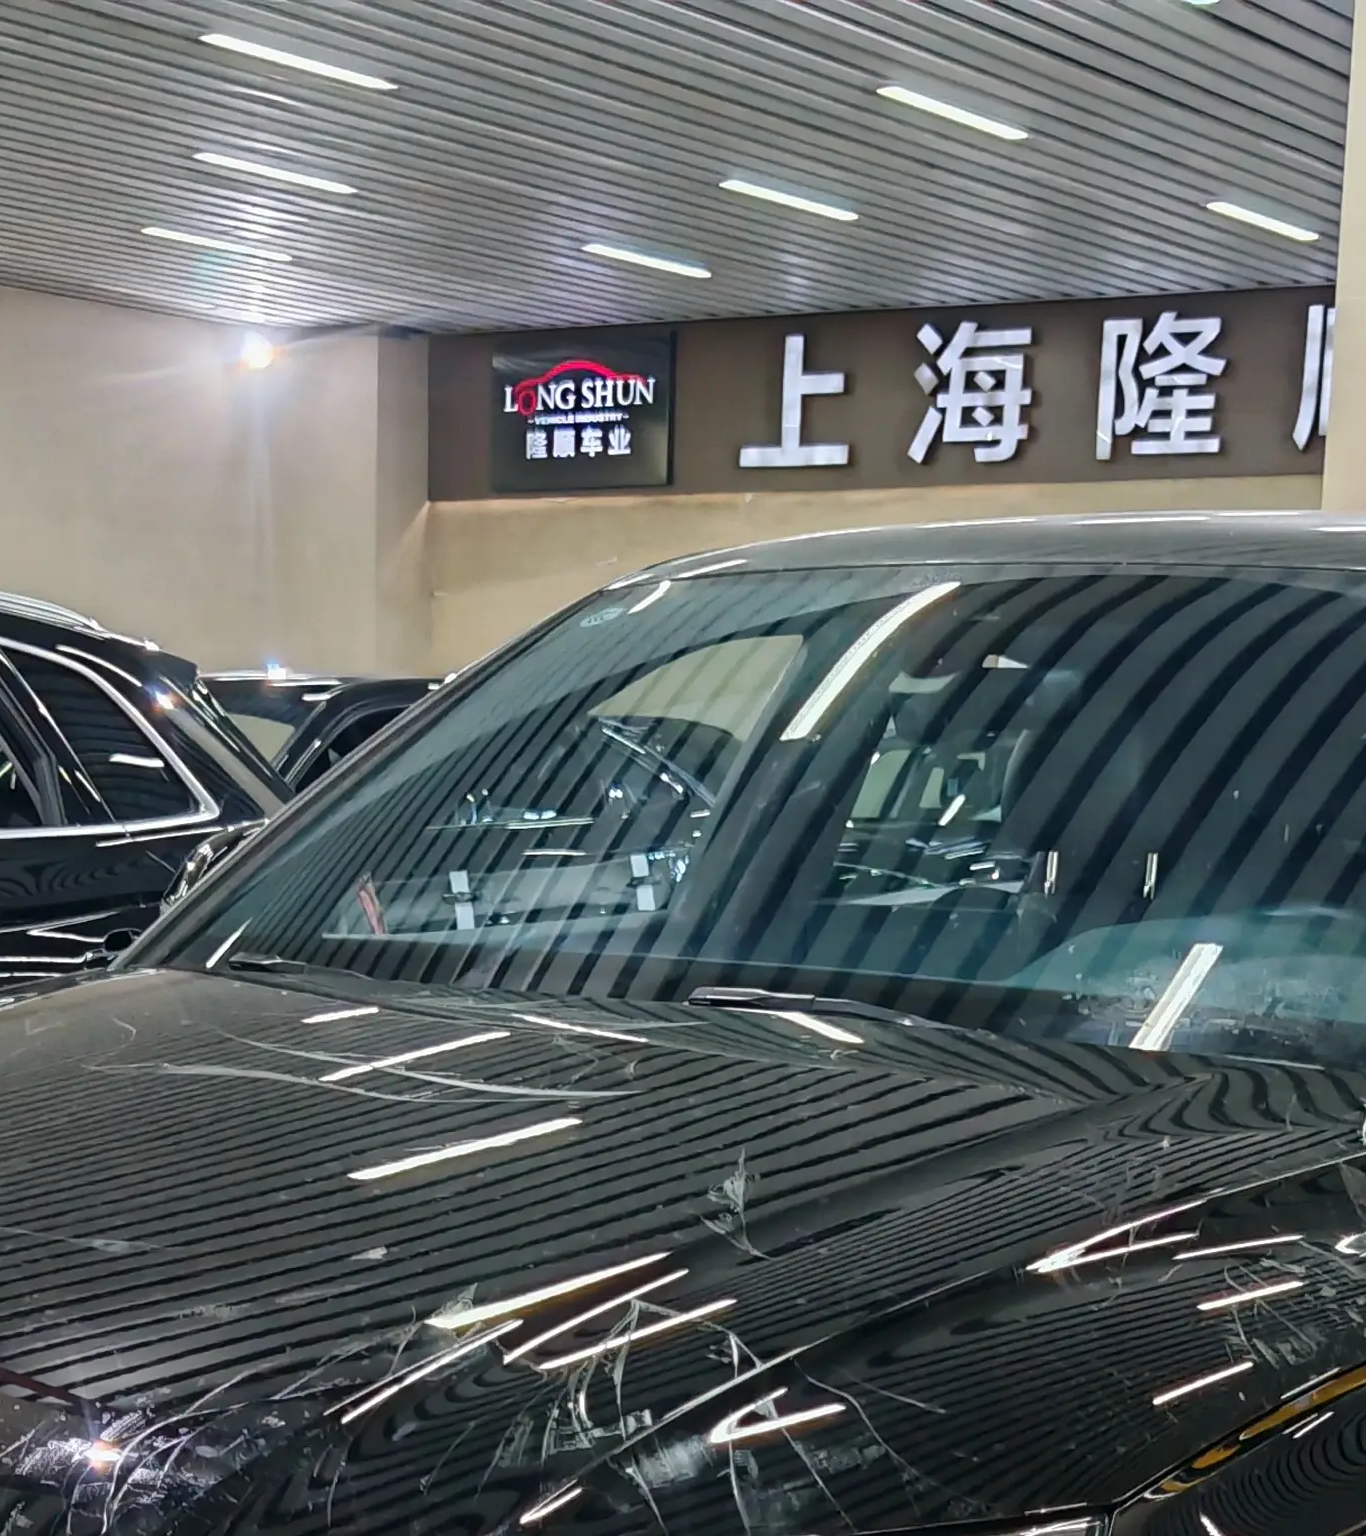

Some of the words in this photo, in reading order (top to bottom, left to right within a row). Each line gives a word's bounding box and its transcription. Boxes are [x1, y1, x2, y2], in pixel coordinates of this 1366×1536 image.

[503, 379, 576, 415] LONG
[581, 375, 656, 408] SHUN
[739, 303, 1337, 468] 上海隆
[526, 424, 632, 460] 隆顺车业
